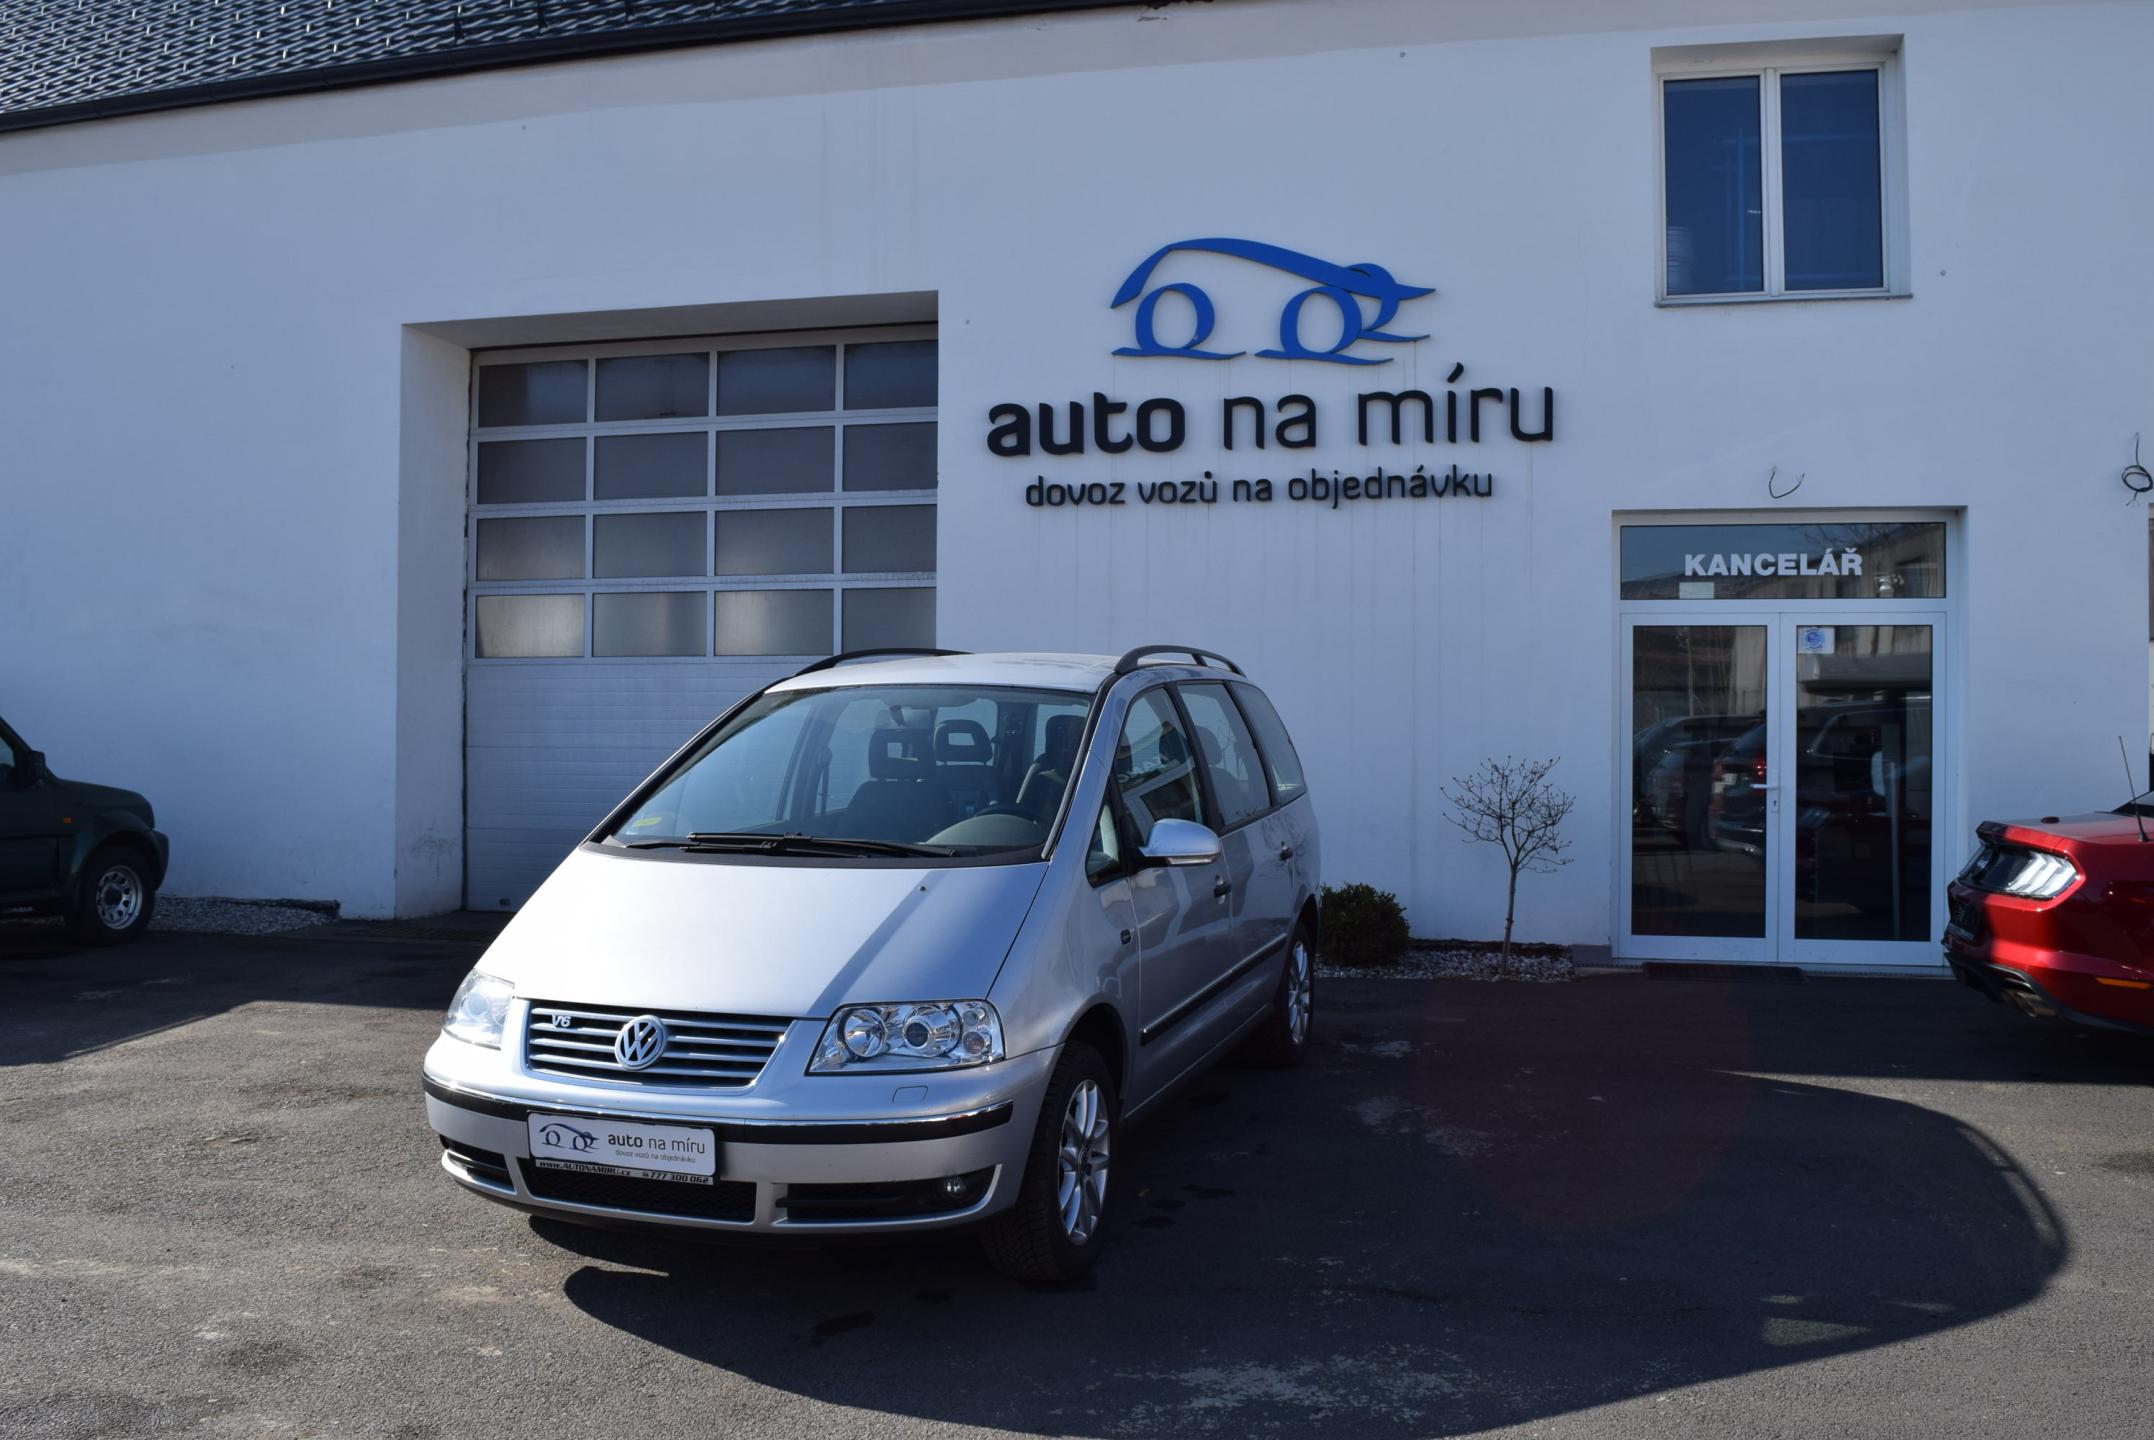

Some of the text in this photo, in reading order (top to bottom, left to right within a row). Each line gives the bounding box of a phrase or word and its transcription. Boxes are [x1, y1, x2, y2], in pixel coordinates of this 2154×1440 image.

[987, 362, 1554, 457] auto na míru
[1025, 464, 1493, 510] dovoz vozů na objednávku
[1684, 547, 1863, 577] KANCELÁŘ
[551, 1013, 572, 1028] V6
[607, 1133, 705, 1154] auto na míru
